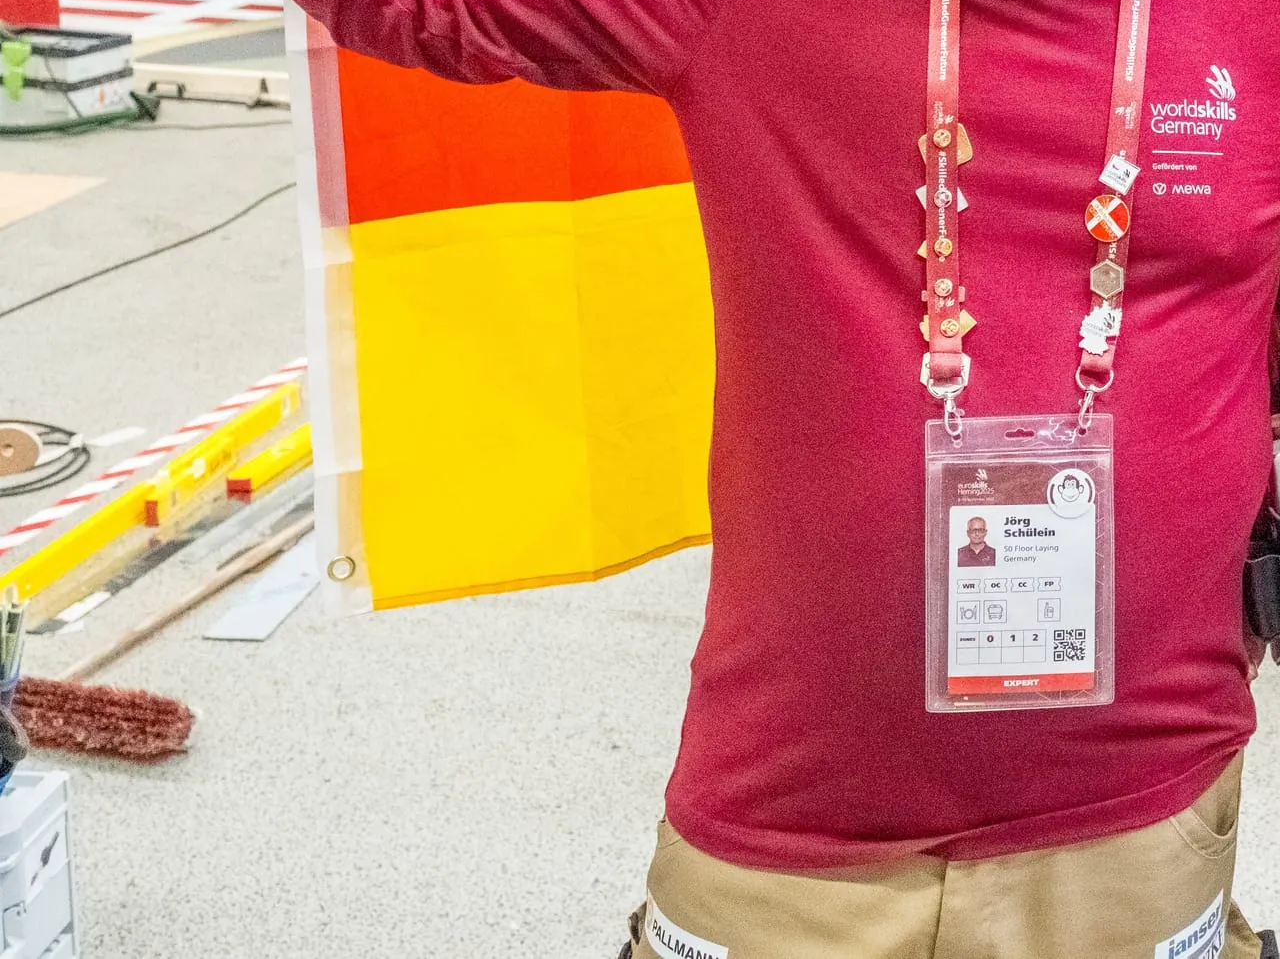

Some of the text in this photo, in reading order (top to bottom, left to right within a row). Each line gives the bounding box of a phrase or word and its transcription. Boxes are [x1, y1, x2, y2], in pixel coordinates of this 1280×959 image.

[1150, 99, 1237, 121] worldskills
[1151, 116, 1223, 140] Germany
[1152, 162, 1184, 171] Gefördert
[1004, 516, 1031, 528] Jörg
[1004, 527, 1056, 538] Schülein
[1003, 543, 1059, 554] 50 Floor Laying
[1003, 555, 1037, 563] Germany
[986, 635, 994, 643] 0
[1009, 634, 1016, 642] 1
[1032, 633, 1039, 641] 2
[1003, 679, 1040, 688] EXPERT
